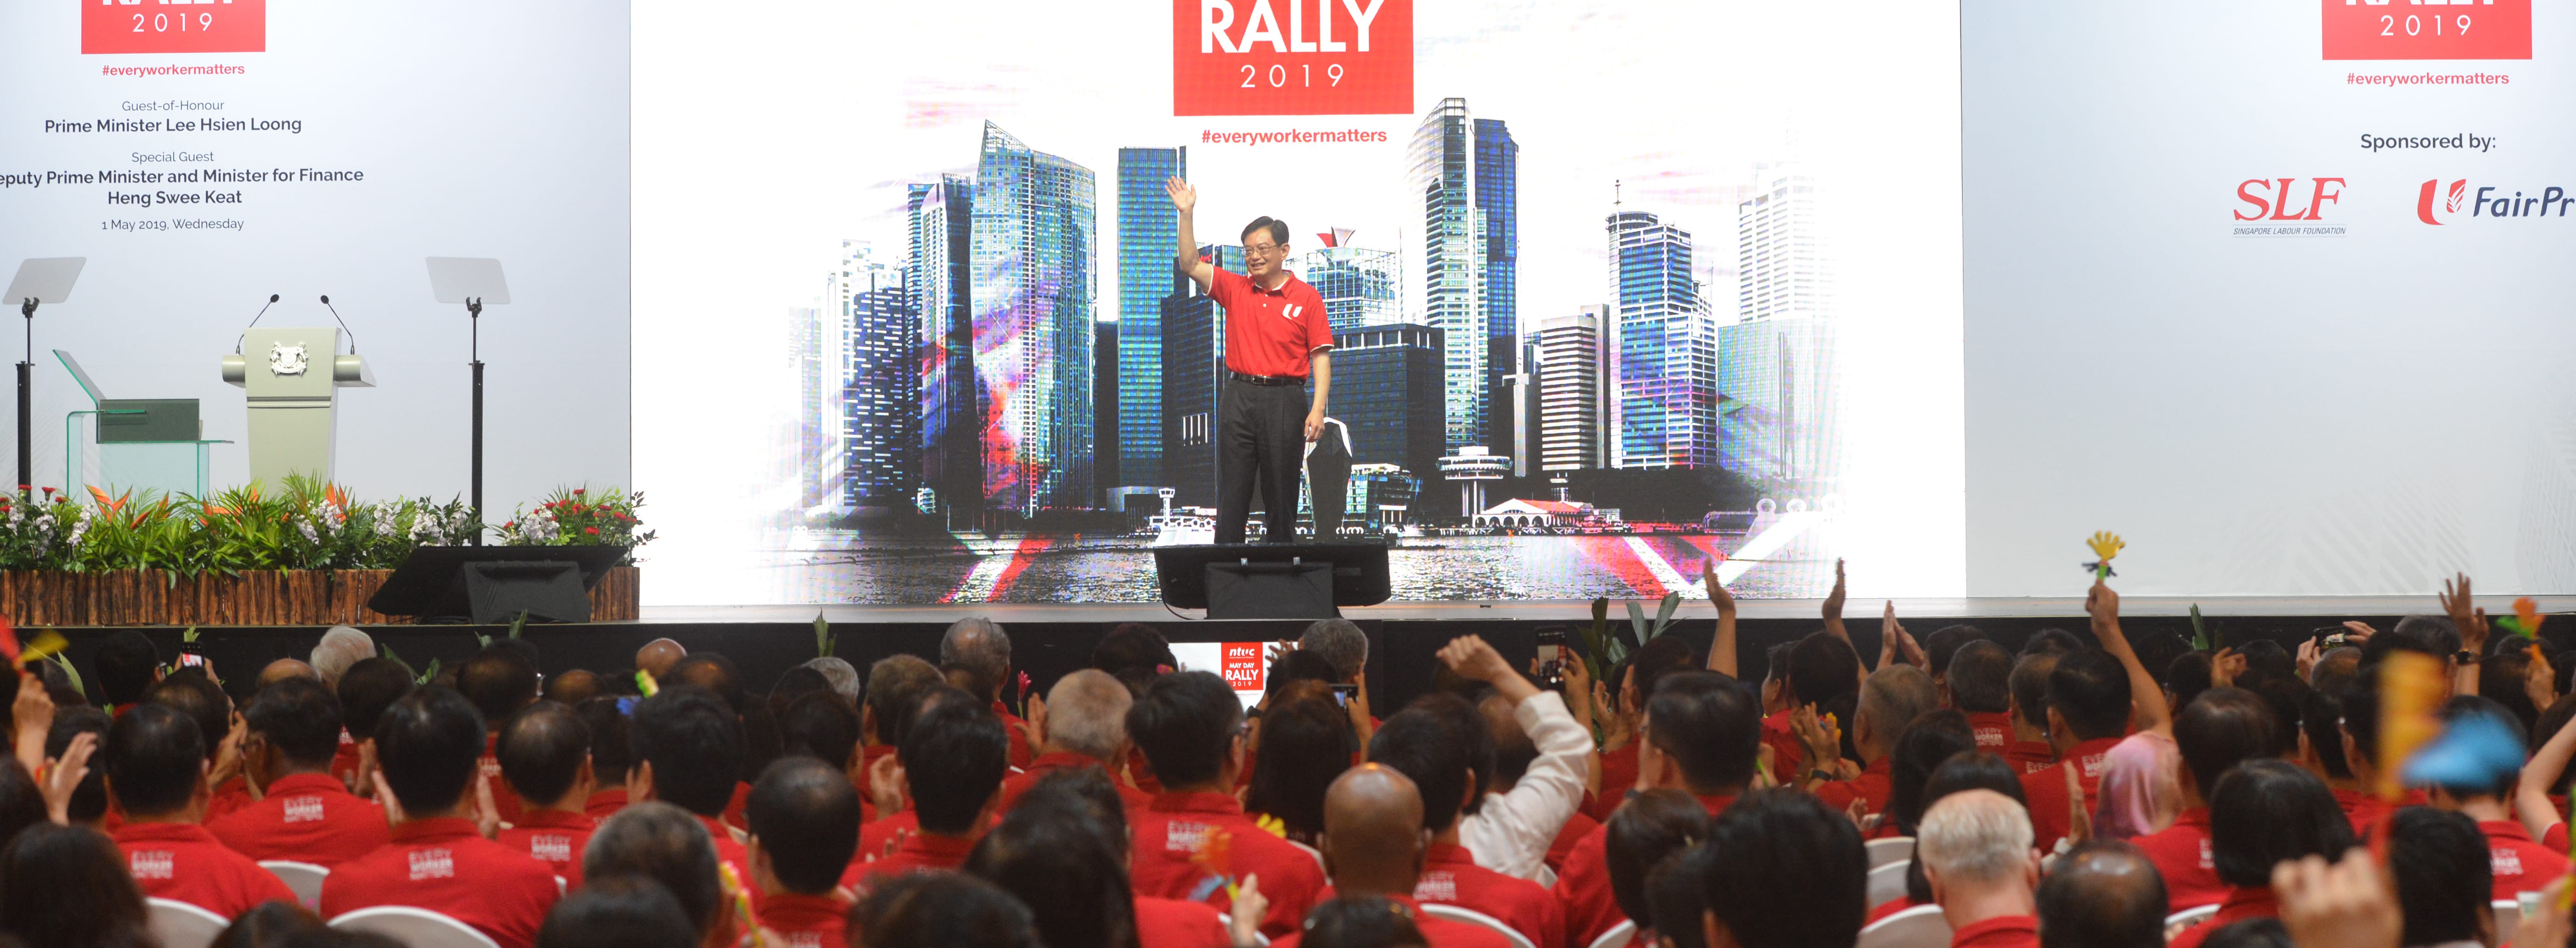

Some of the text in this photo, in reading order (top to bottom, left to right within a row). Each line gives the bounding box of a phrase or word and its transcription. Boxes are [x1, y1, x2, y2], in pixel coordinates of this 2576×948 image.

[133, 13, 212, 32] 2019
[1201, 0, 1385, 53] RALLY
[2380, 15, 2471, 36] 2019
[102, 64, 245, 78] #everyworkermatters
[1241, 64, 1344, 88] 2019
[2346, 72, 2509, 87] #everyworkermatters
[122, 100, 224, 111] Guest-of-Honour
[45, 118, 301, 134] Prime Minister Lee Hsien Loong
[1202, 128, 1387, 146] #everyworkermatters
[2361, 133, 2496, 153] Sponsored by:
[132, 151, 214, 165] Special Guest
[47, 170, 94, 184] Prime
[98, 169, 164, 184] Minister
[167, 169, 198, 183] and
[203, 168, 269, 182] Minister
[272, 168, 295, 182] for
[300, 168, 364, 181] Finance
[108, 190, 242, 208] Heng Swee Keat
[2233, 177, 2346, 221] SLF
[2473, 186, 2576, 217] FairPr
[102, 218, 244, 232] 1 May 2019, Wednesday
[1225, 669, 1259, 680] RALLY
[1420, 871, 1456, 881] VERY
